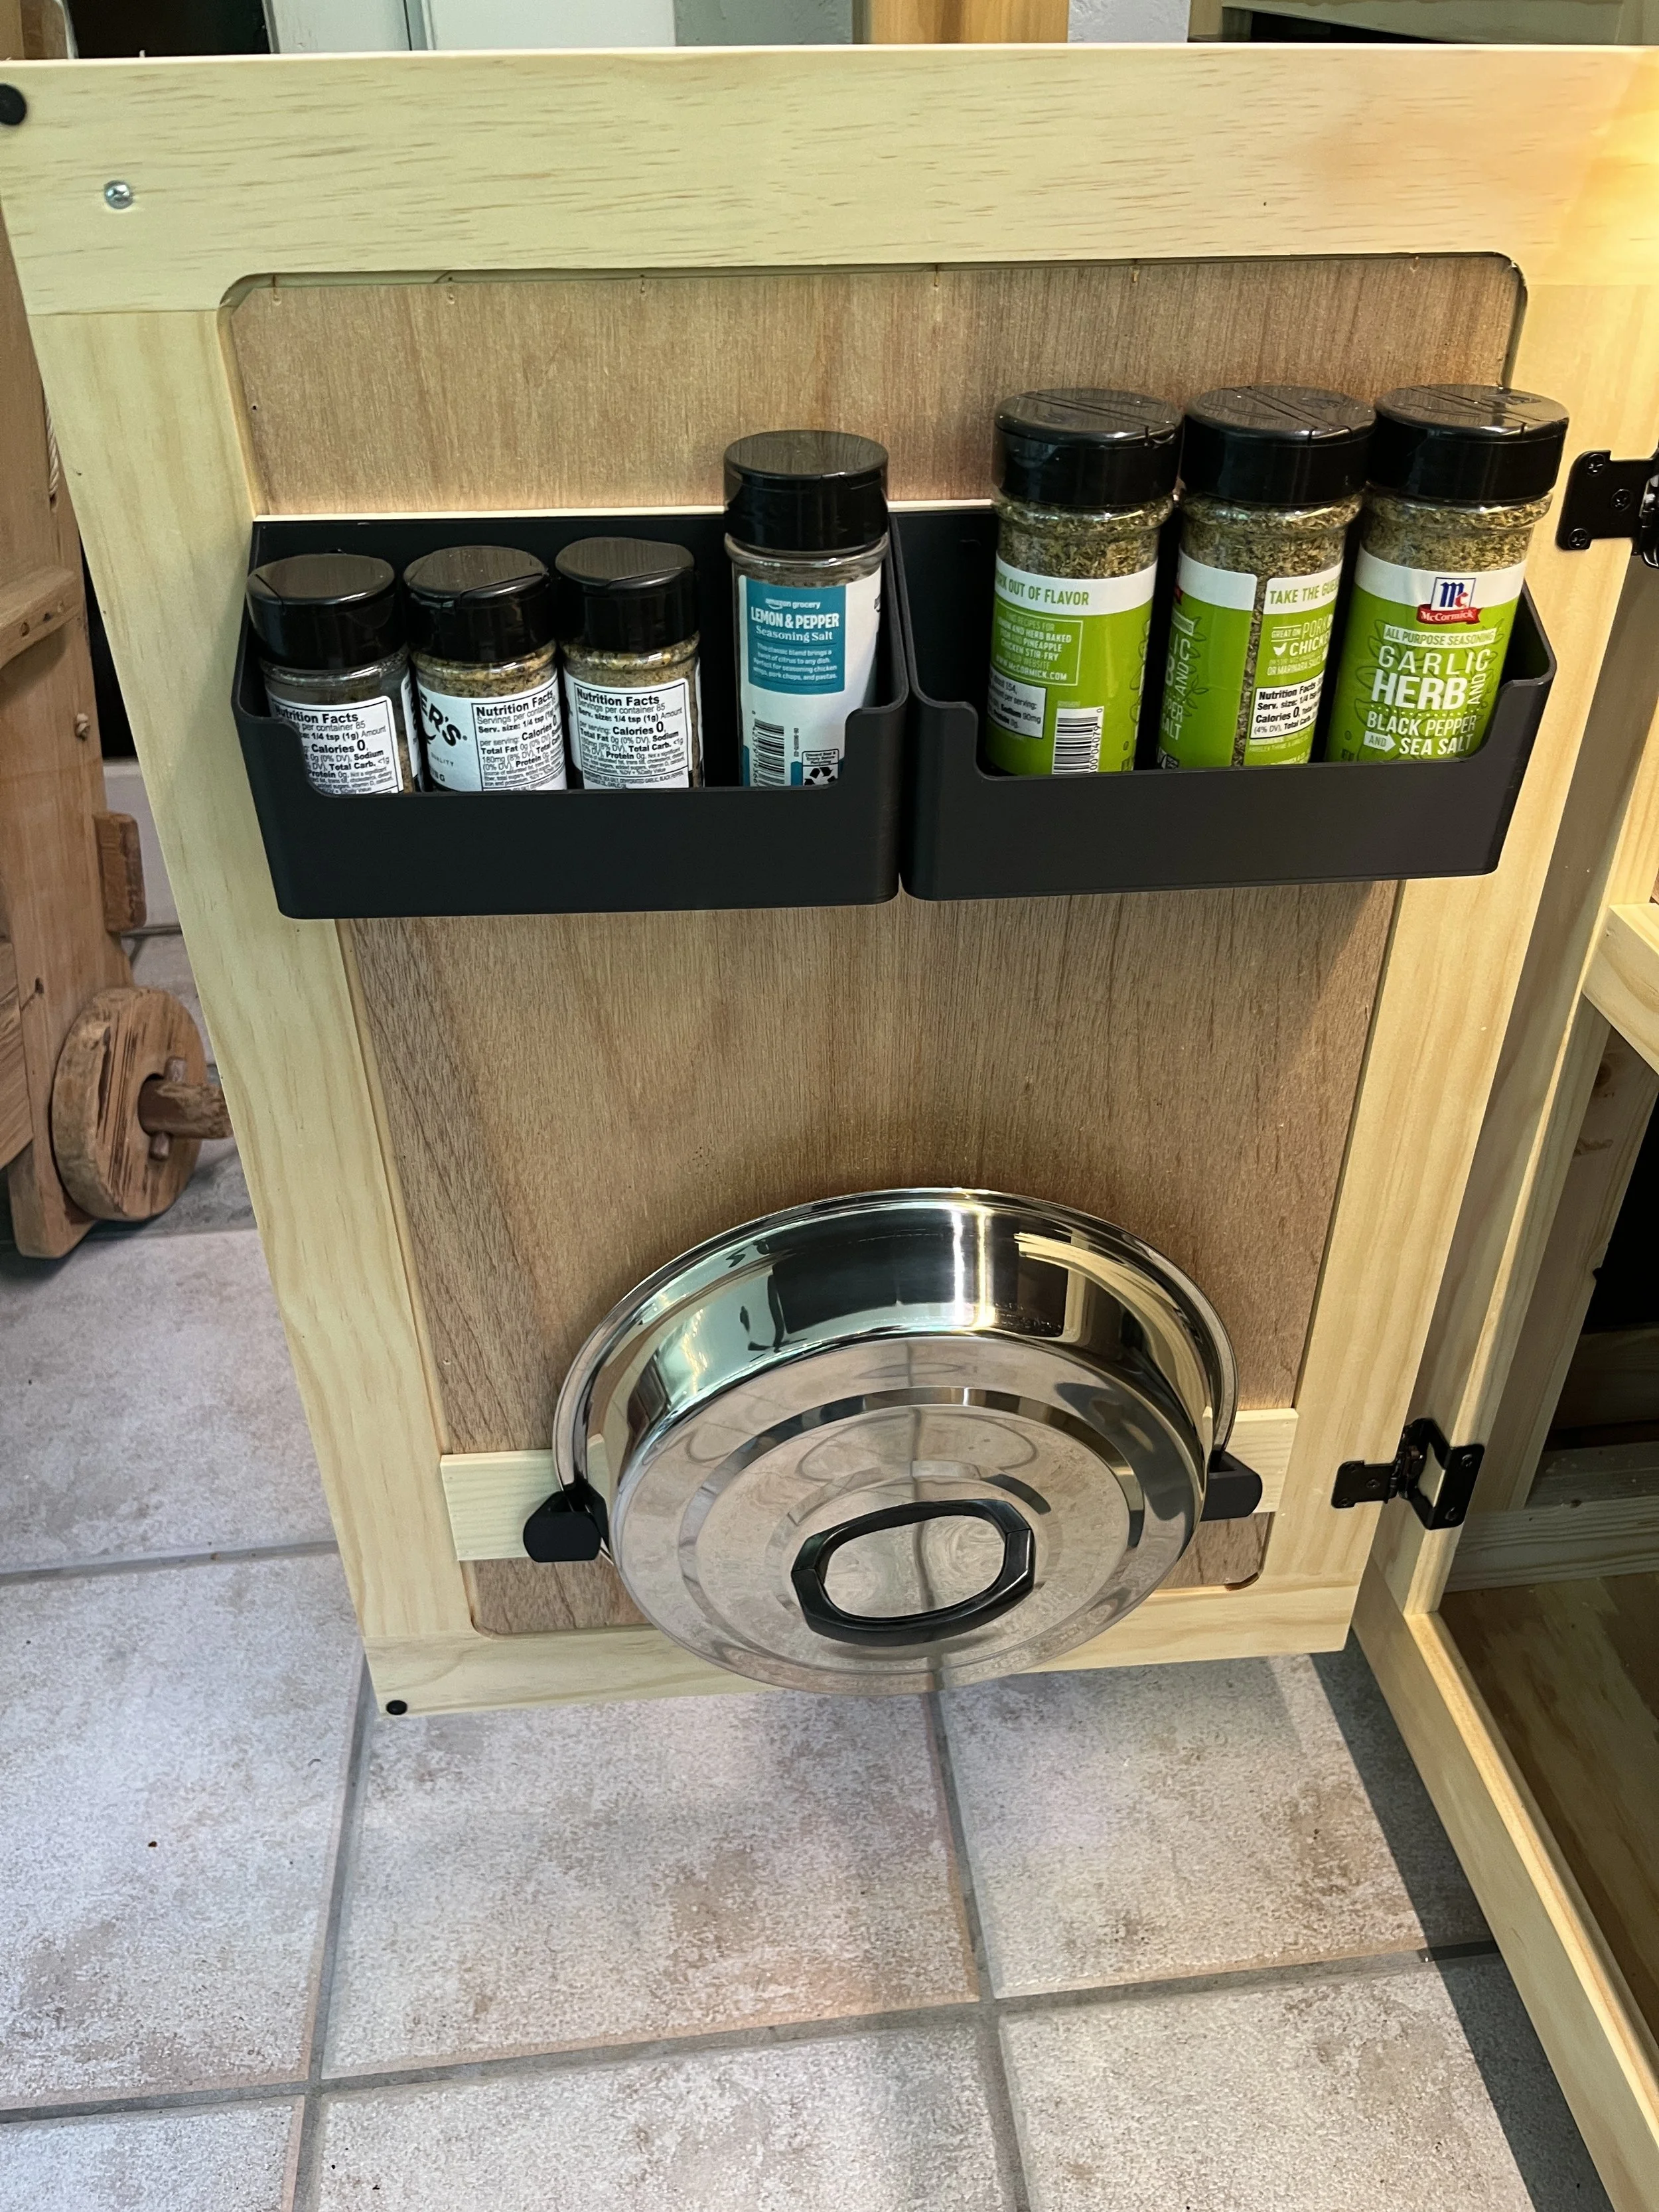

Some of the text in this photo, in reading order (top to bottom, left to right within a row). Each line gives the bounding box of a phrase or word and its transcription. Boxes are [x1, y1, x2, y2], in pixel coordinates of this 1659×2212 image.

[1009, 579, 1025, 597] OUT
[1028, 585, 1041, 601] OF
[1044, 589, 1089, 605] FLAVOR
[1269, 585, 1321, 605] TAKE THE
[792, 601, 821, 610] grocery
[751, 606, 839, 629] LEMON & PEPPER
[1421, 610, 1475, 622] McCormick
[756, 625, 833, 644] Seasoning Salt
[1025, 629, 1044, 640] HERB
[1046, 632, 1072, 643] BAKED
[1271, 629, 1292, 638] GREAT
[1386, 627, 1494, 646] ALL PURPOSE SEASONING
[1023, 637, 1062, 652] PINEAPPLE
[1378, 645, 1492, 676] GARLIC
[1259, 682, 1316, 701] Nutrition Facts
[1371, 668, 1469, 711] HERB
[1467, 672, 1487, 705] AND
[476, 690, 553, 717] Nutrition Facts
[577, 688, 660, 707] Nutrition Facts
[275, 703, 358, 723] Nutrition Facts
[595, 713, 613, 721] size:
[628, 715, 641, 724] tsp
[643, 713, 659, 723] (1g)
[661, 707, 682, 719] Amount
[619, 705, 655, 714] container
[316, 723, 354, 731] container
[356, 720, 366, 729] 85
[477, 716, 512, 725] Servings
[514, 713, 526, 723] per
[502, 723, 521, 732] size:
[523, 719, 533, 728] 1/4
[1256, 713, 1291, 723] Calories
[1284, 720, 1299, 729] Total
[1367, 710, 1477, 737] BLACK PEPPER
[326, 733, 340, 742] tsp
[342, 731, 359, 741] (1g)
[361, 726, 387, 737] Amount
[522, 723, 552, 741] Calories
[580, 727, 595, 739] Total
[597, 733, 609, 742] Fat
[652, 731, 680, 742] Sodium
[613, 726, 654, 736] Calories
[628, 743, 650, 752] Total
[652, 741, 672, 751] Carb.
[1368, 731, 1386, 747] AND
[1399, 733, 1474, 755] SEA SALT
[311, 743, 354, 754] Calories
[354, 750, 384, 761] Sodium
[536, 743, 551, 754] Total
[606, 751, 634, 760] Protein
[354, 761, 376, 769] Carb.
[516, 755, 541, 767] Protein
[308, 769, 336, 778] Protein
